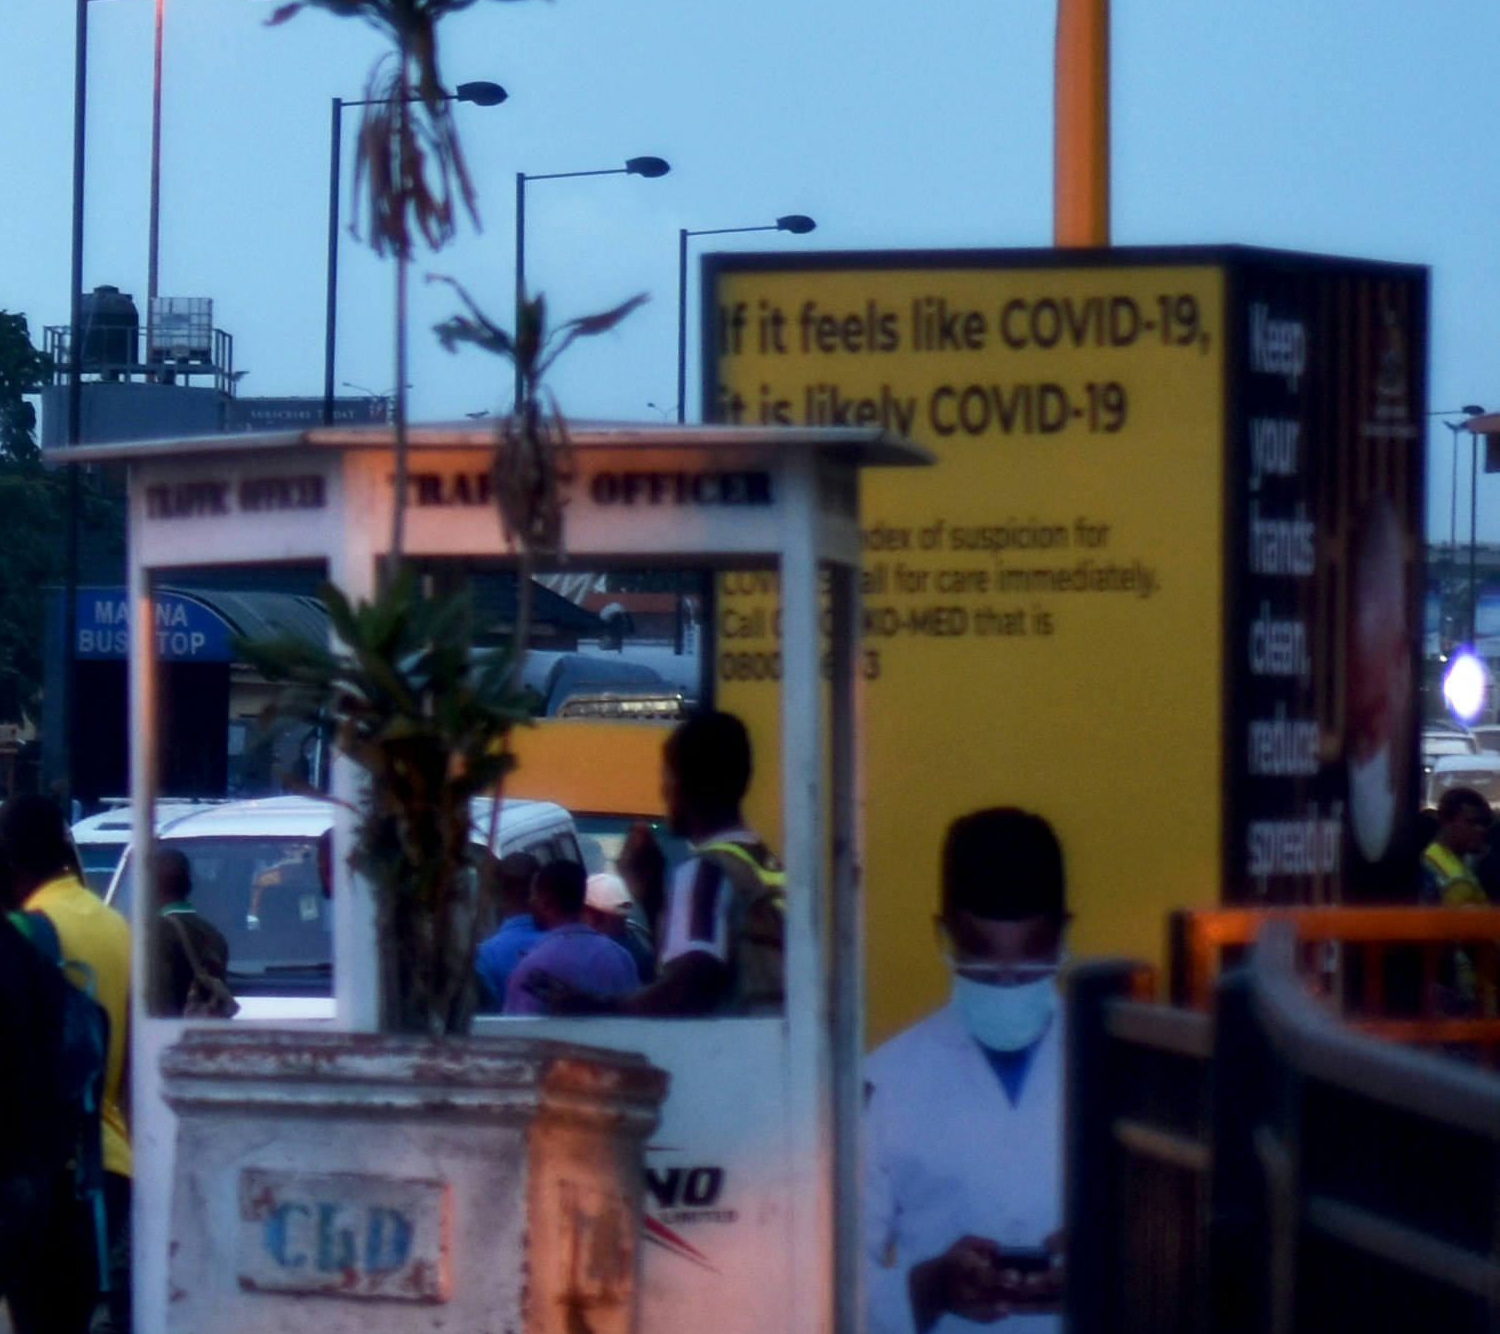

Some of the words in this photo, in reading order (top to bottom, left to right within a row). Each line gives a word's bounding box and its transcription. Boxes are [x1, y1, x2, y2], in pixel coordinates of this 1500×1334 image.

[759, 301, 788, 354] it
[800, 300, 898, 354] feels
[912, 296, 987, 351] like
[1003, 294, 1211, 355] COVID-19,
[318, 410, 355, 420] TDAY
[805, 383, 916, 437] likely
[930, 380, 1127, 437] COVID-19
[94, 600, 190, 627] MANA
[153, 631, 205, 655] TOP
